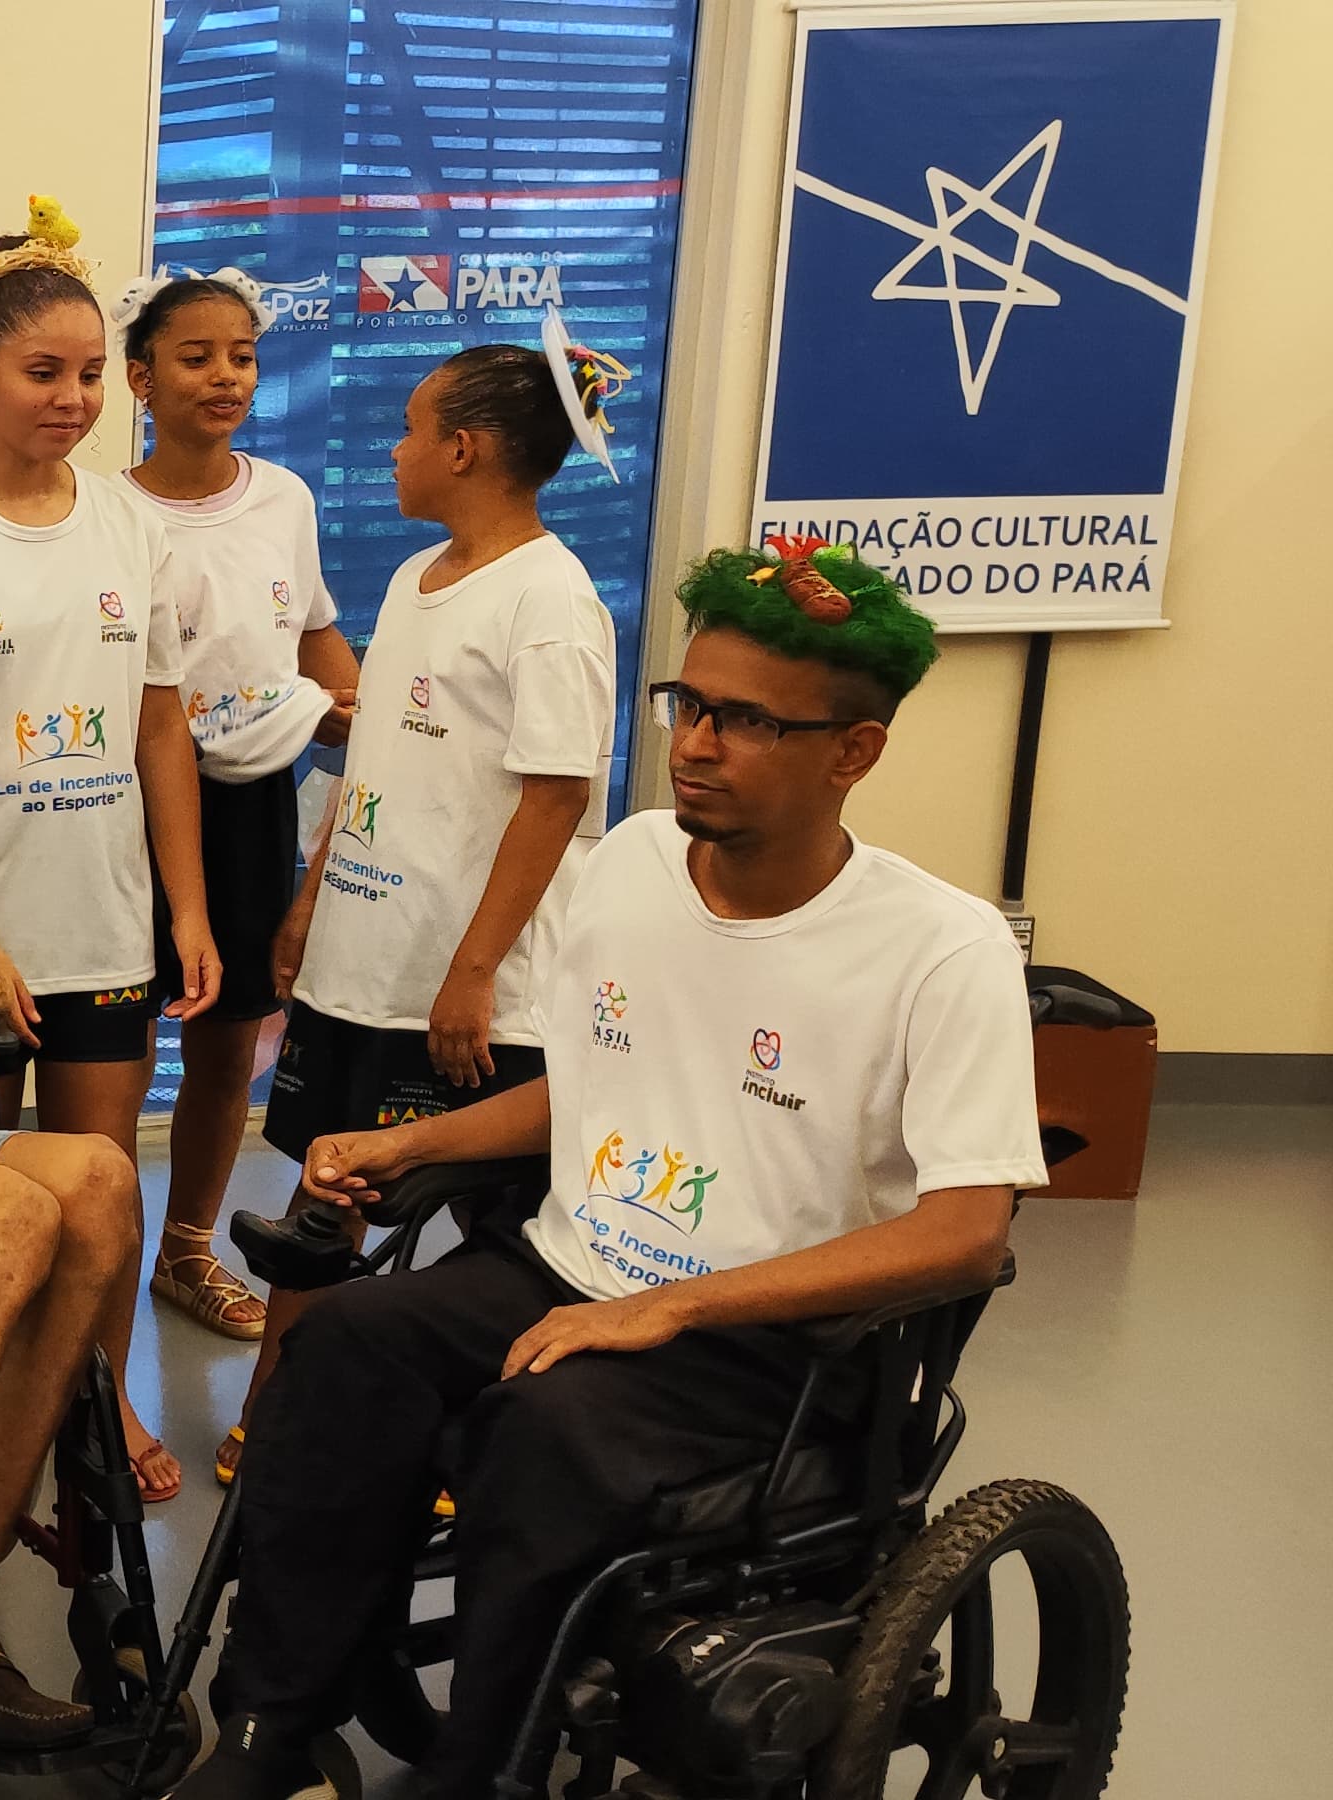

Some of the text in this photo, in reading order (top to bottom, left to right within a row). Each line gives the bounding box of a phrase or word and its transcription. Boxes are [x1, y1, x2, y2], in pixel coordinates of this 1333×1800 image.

[309, 322, 330, 331] PAZ
[356, 317, 396, 328] POR
[412, 313, 468, 326] TODO
[971, 514, 1159, 548] CULTURAL
[985, 563, 1040, 595] DO
[1052, 555, 1151, 592] PARÁ
[399, 716, 449, 739] incluir
[29, 780, 52, 794] de
[60, 772, 133, 791] Incentivo
[22, 791, 116, 813] ao Esporte
[742, 1077, 806, 1111] incluir
